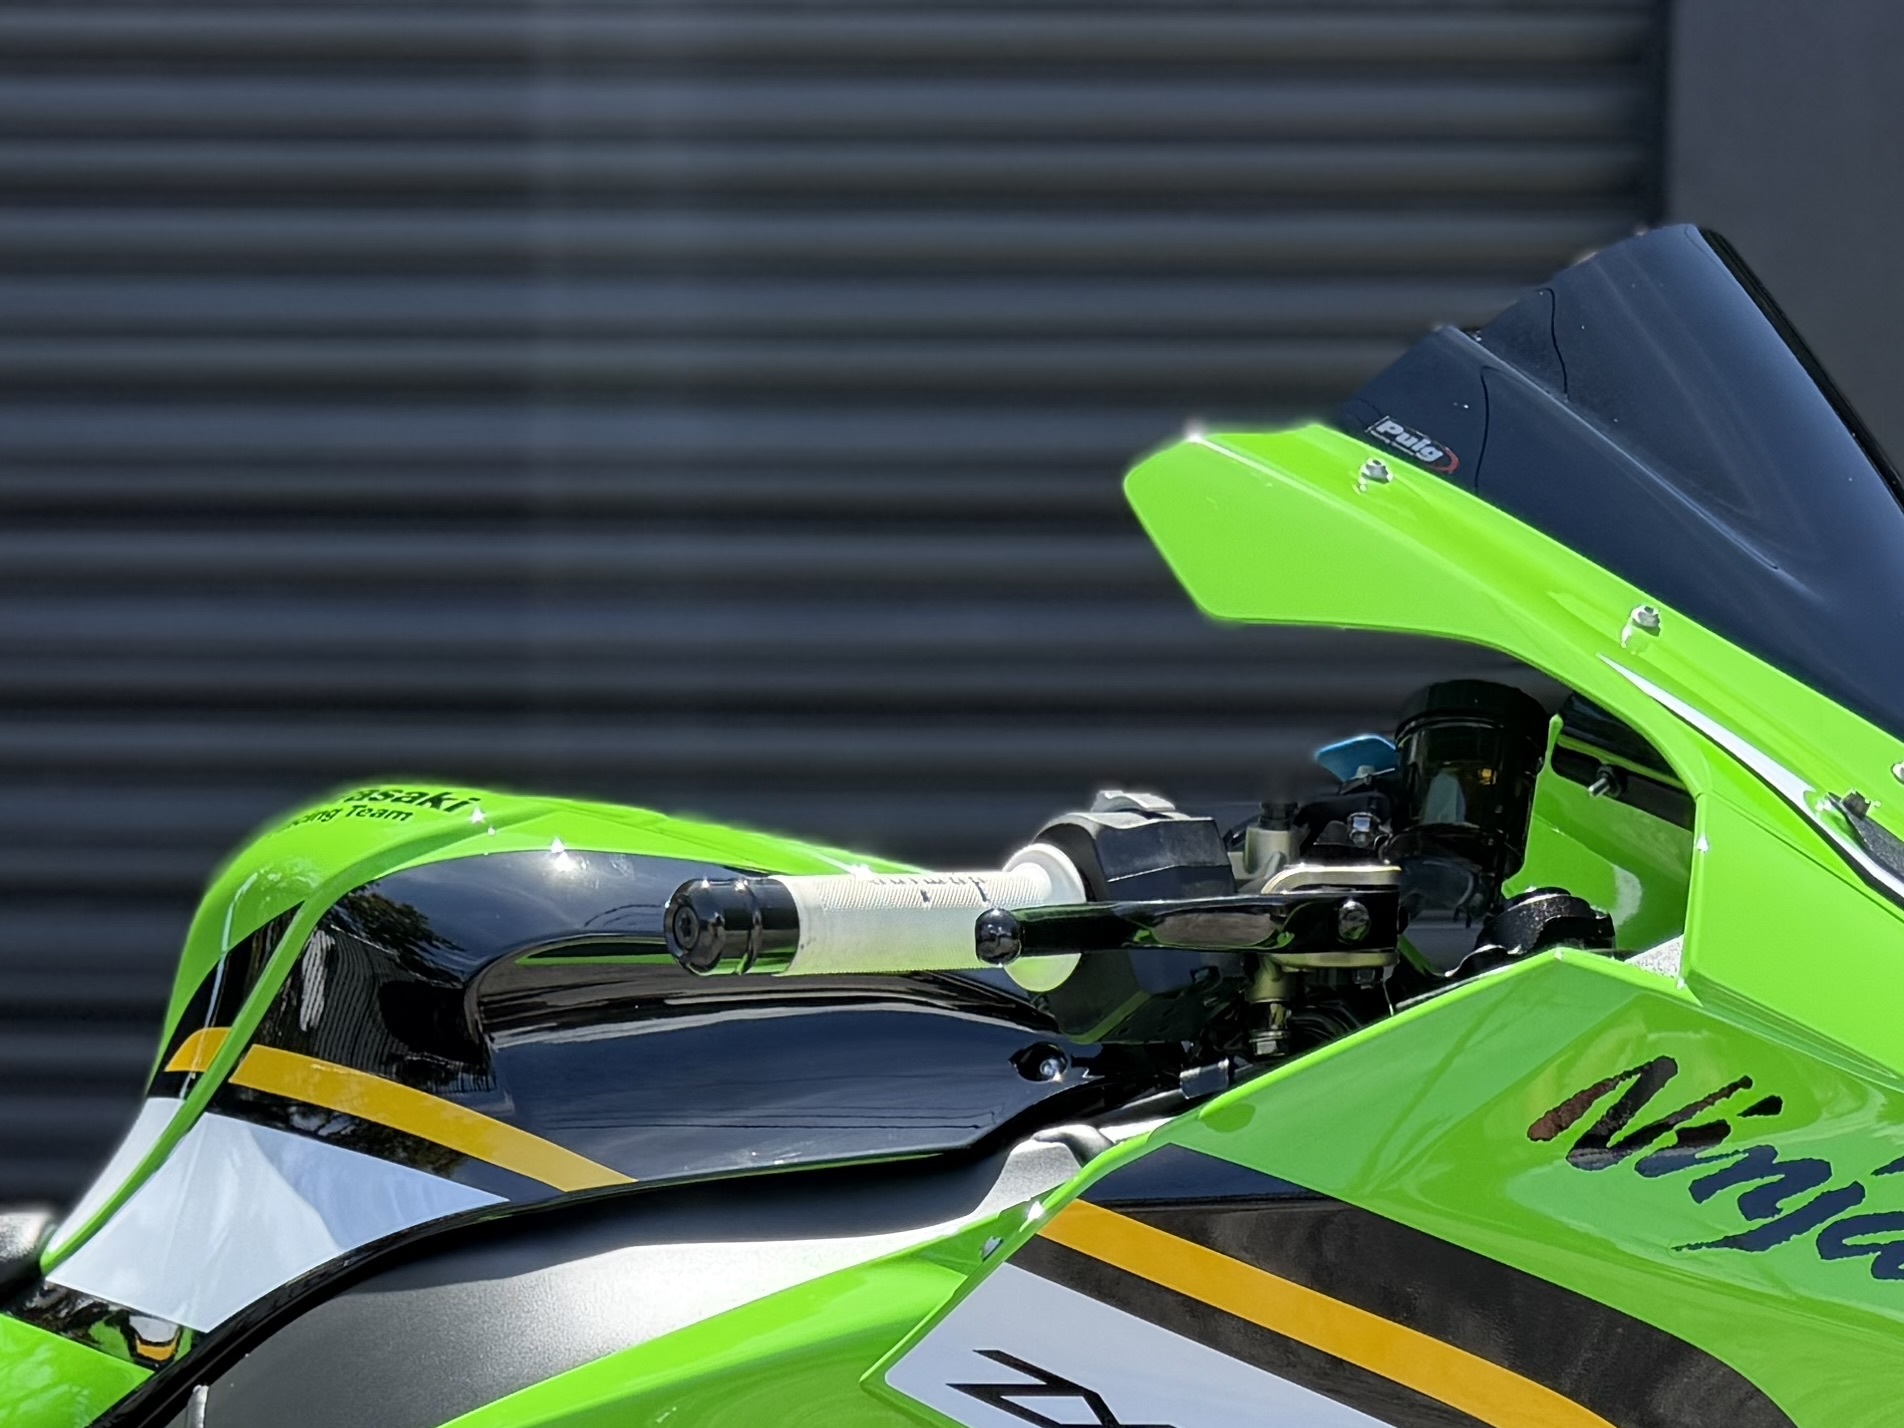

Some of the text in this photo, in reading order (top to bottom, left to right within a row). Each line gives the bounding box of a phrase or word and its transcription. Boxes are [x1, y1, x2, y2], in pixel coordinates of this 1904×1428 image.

[1375, 420, 1444, 462] Puig
[343, 788, 481, 813] asaki
[346, 804, 414, 822] Team
